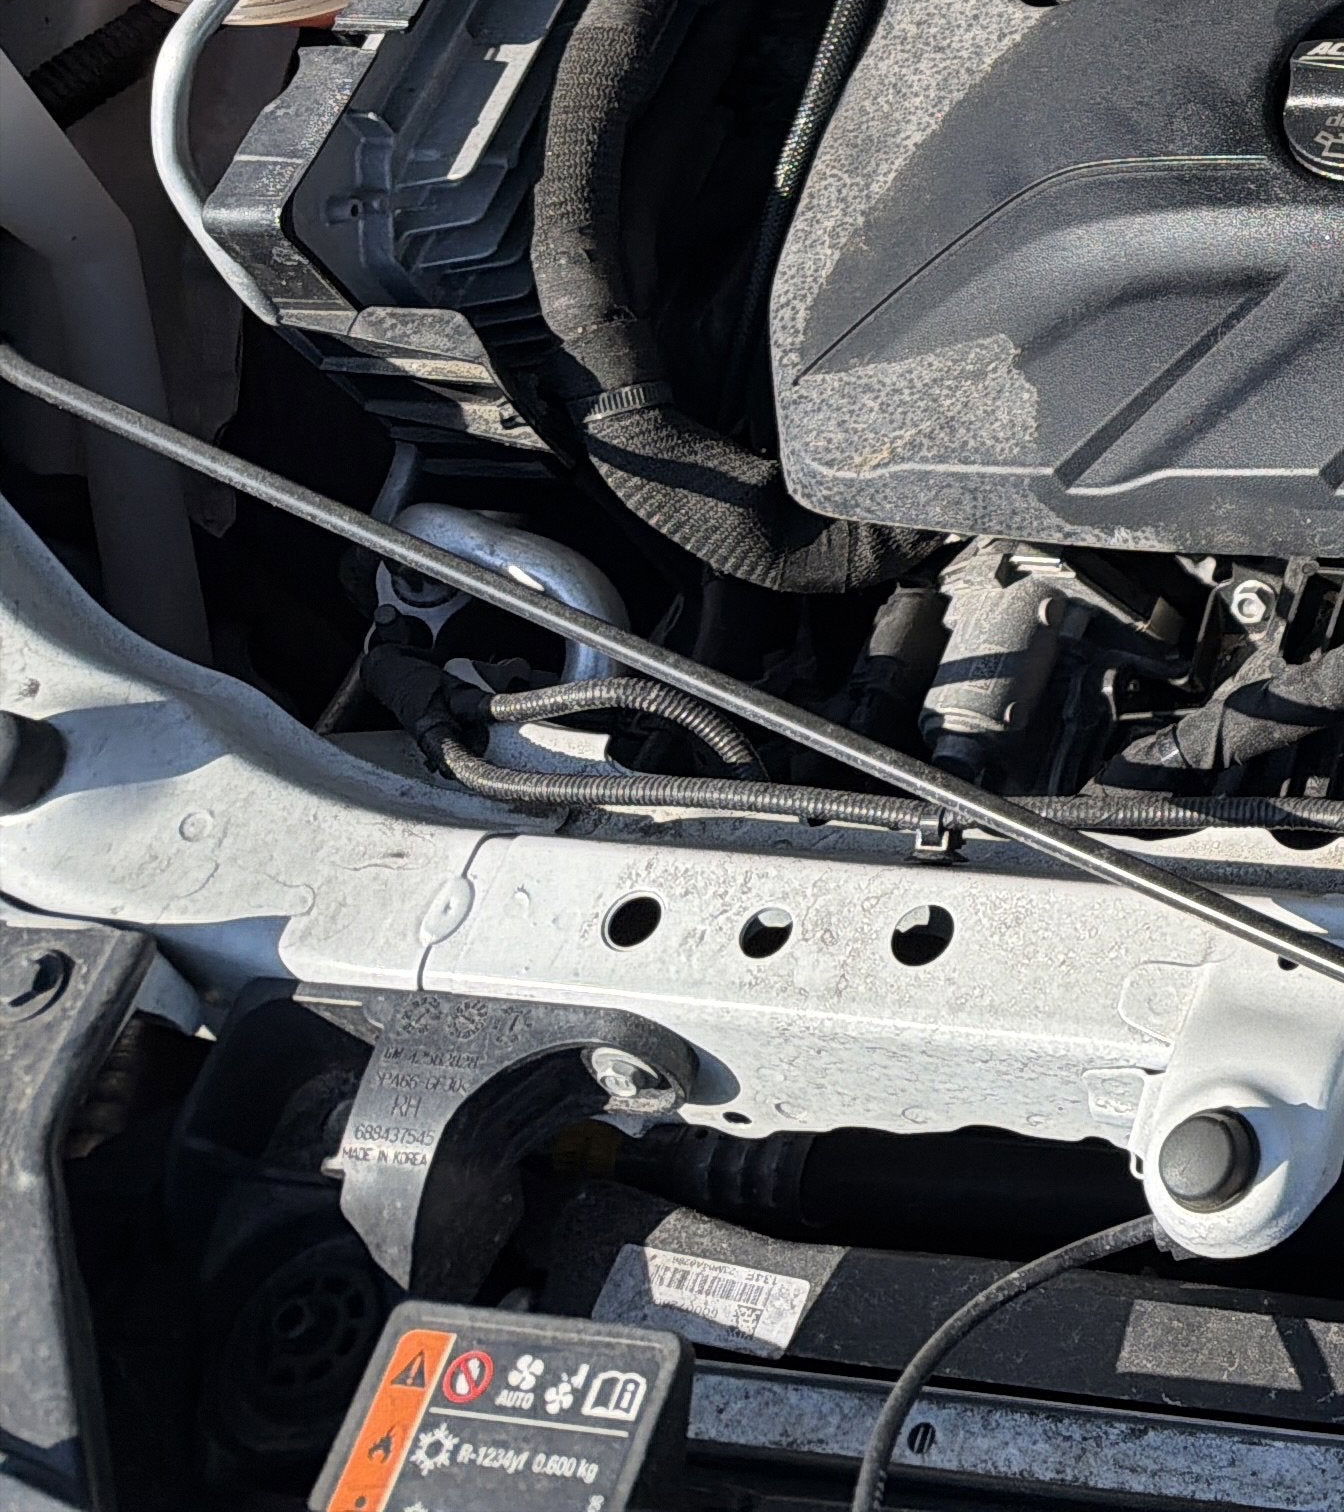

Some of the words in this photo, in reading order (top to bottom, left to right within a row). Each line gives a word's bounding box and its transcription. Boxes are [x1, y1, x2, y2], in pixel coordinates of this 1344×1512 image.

[391, 1094, 422, 1118] RH
[342, 1146, 373, 1162] MADE
[377, 1149, 389, 1163] IN
[393, 1151, 428, 1166] KOREA
[495, 1389, 535, 1410] AUTO
[457, 1443, 529, 1474] R-1234yf
[532, 1453, 577, 1478] 0.600
[576, 1457, 599, 1484] kg
